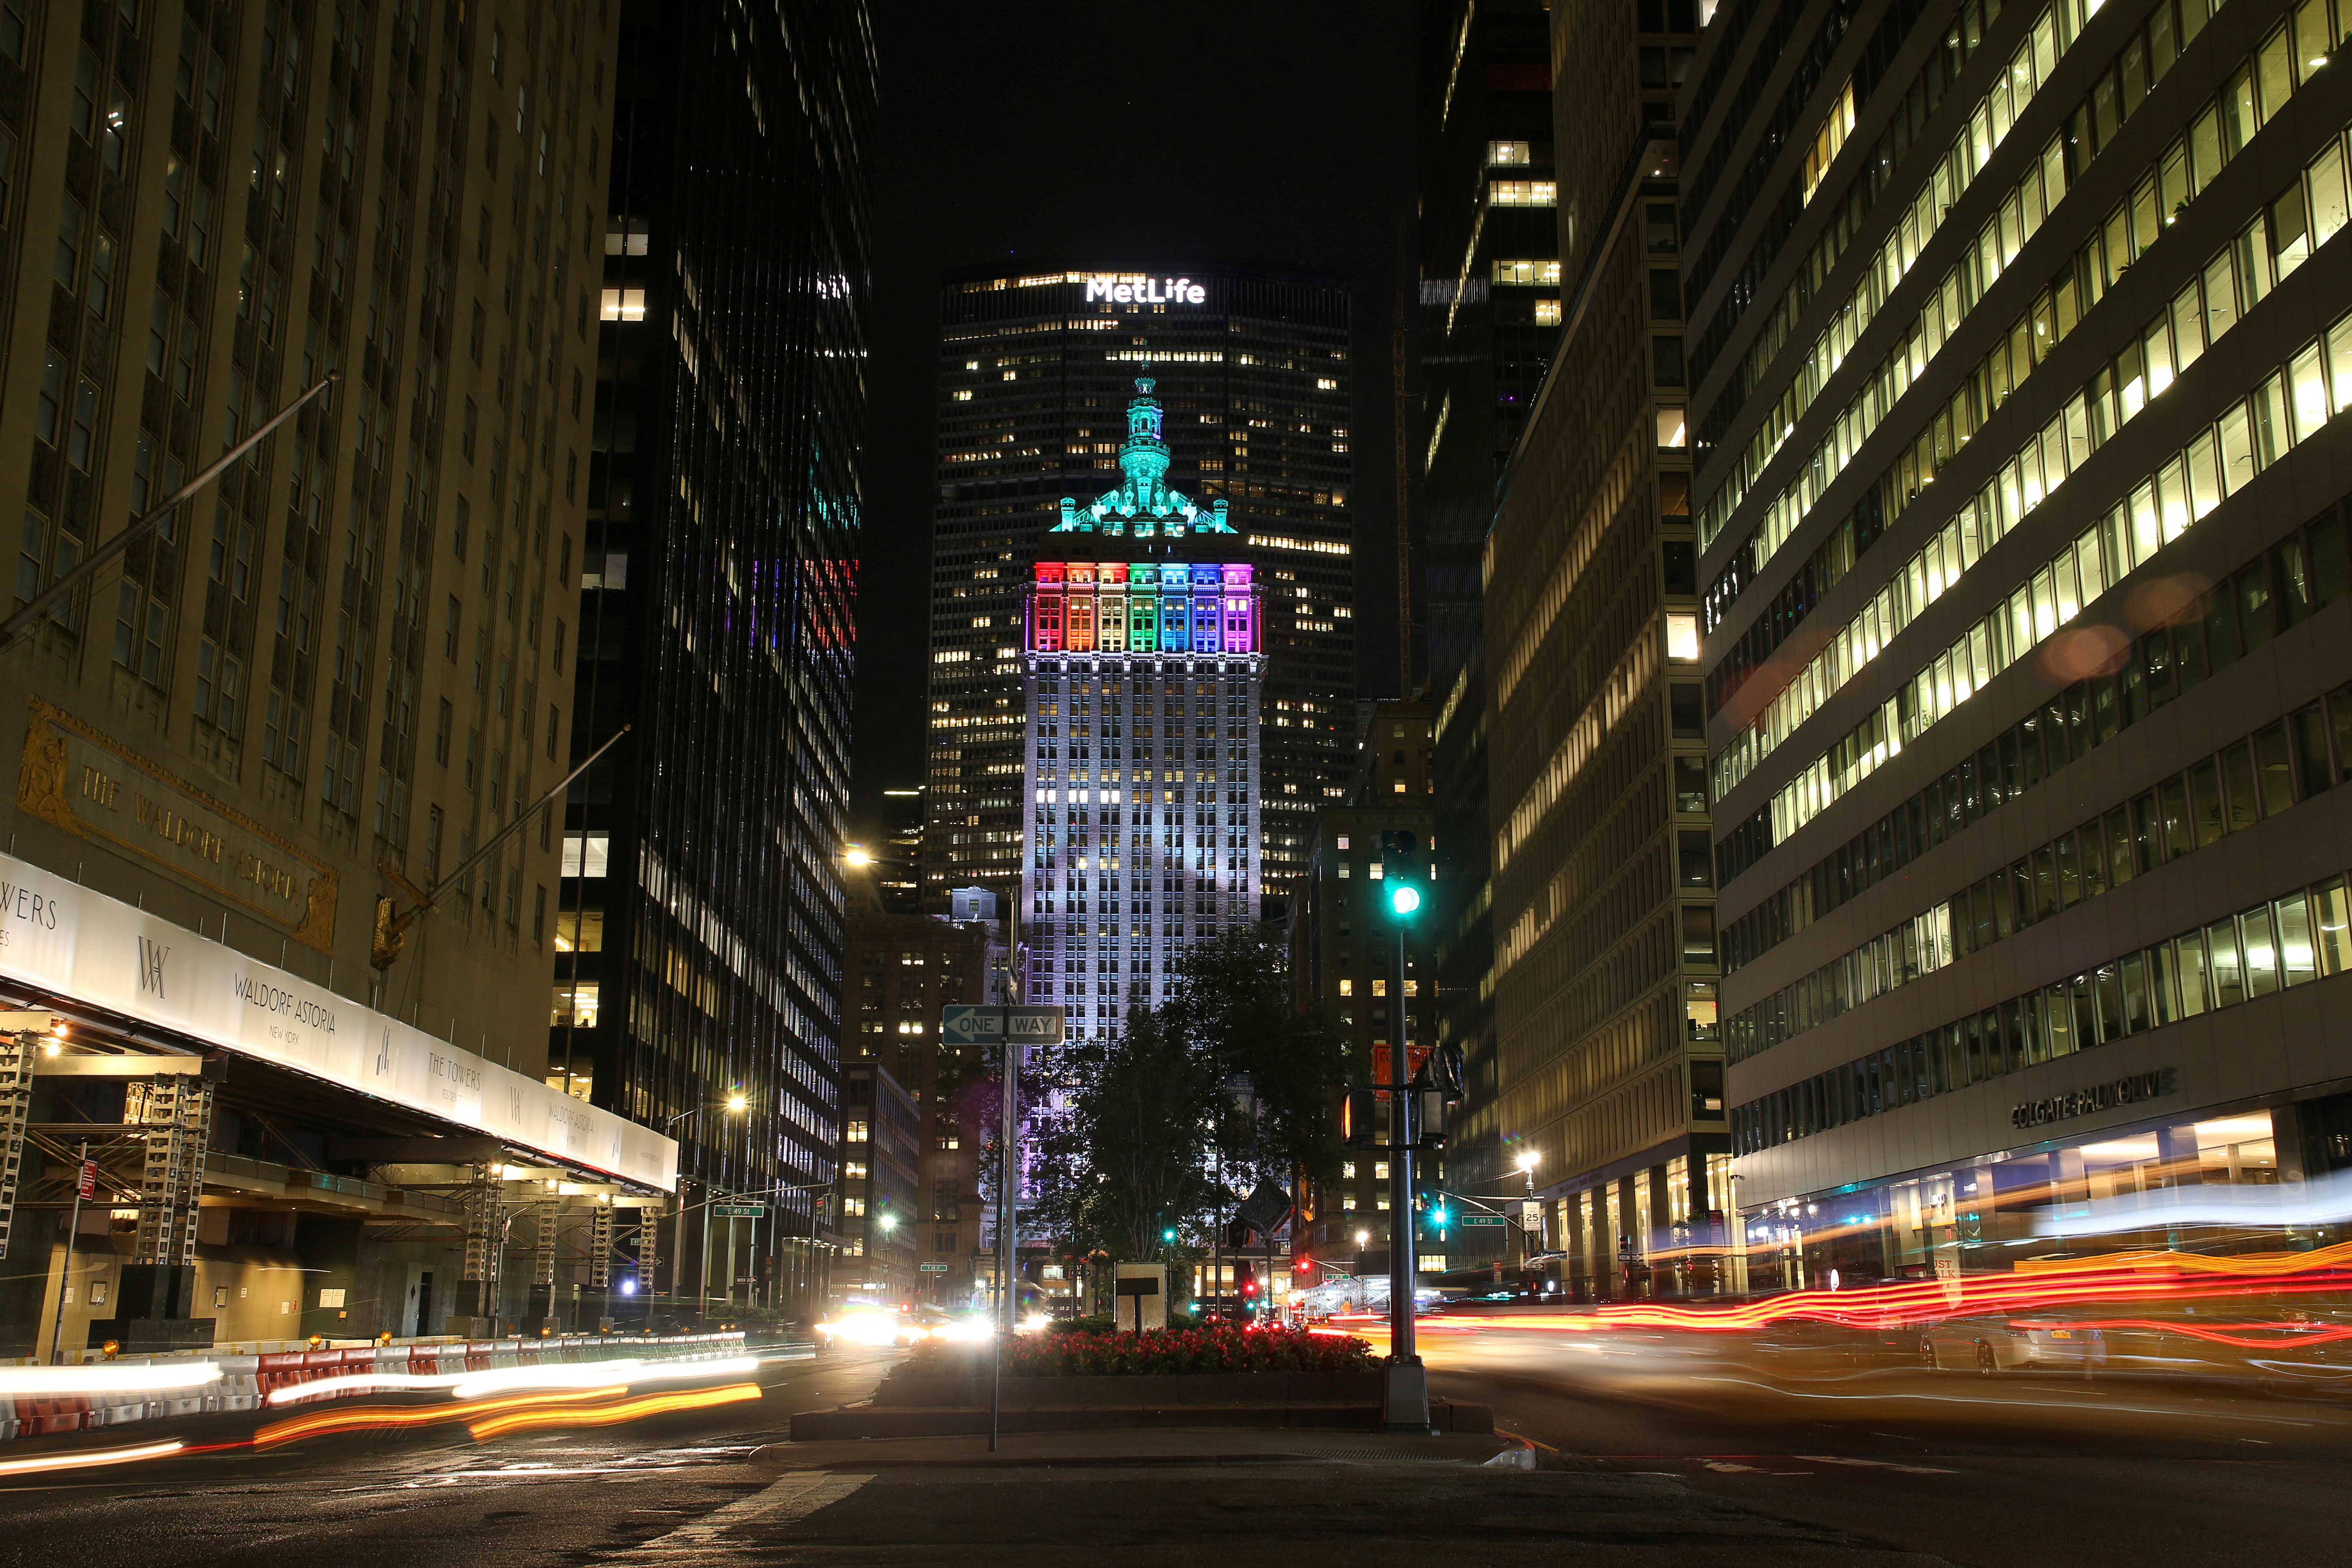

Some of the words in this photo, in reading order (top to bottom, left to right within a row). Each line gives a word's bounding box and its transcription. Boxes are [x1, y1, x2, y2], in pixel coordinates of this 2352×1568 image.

[1086, 278, 1205, 303] MetLife
[82, 764, 121, 813] THE
[235, 973, 293, 1016] WALDORF
[294, 999, 335, 1036] ASTORIA
[270, 1025, 283, 1039] NEW
[284, 1029, 300, 1046] YORK
[959, 1017, 994, 1033] ONE
[1015, 1017, 1052, 1032] WAY
[429, 1052, 444, 1076] THE
[448, 1060, 481, 1091] TOWERS
[2012, 1068, 2178, 1129] COLGATE-PALMOLIVE
[549, 1102, 574, 1126] WALDORF
[575, 1114, 594, 1134] ASTORIA
